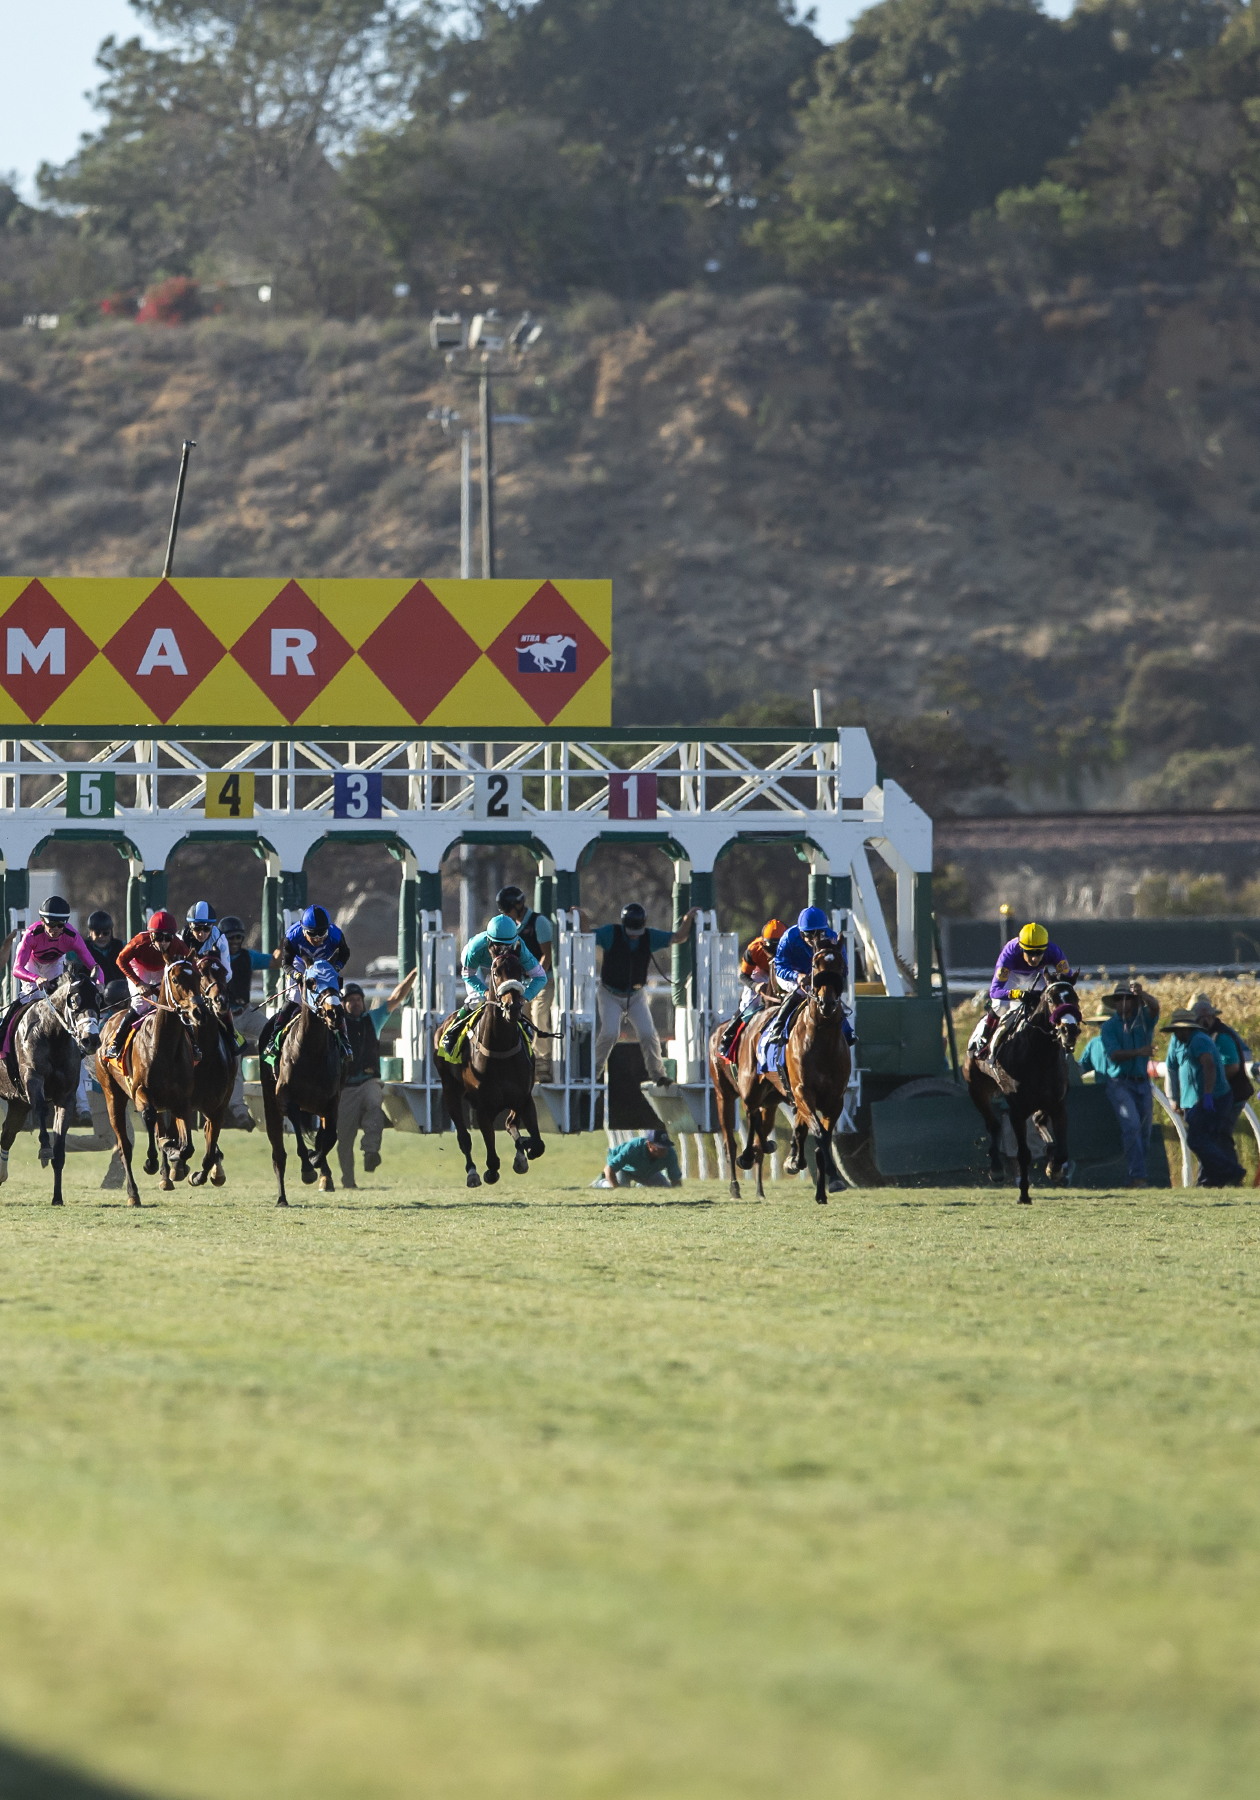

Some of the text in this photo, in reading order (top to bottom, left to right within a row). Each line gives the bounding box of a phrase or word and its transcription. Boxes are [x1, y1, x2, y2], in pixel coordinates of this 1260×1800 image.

[6, 627, 318, 676] MAR
[520, 634, 541, 642] NTRA
[79, 773, 102, 816] 5
[218, 773, 242, 817] 4
[346, 773, 369, 818] 3
[487, 774, 509, 817] 2
[622, 775, 639, 818] 1
